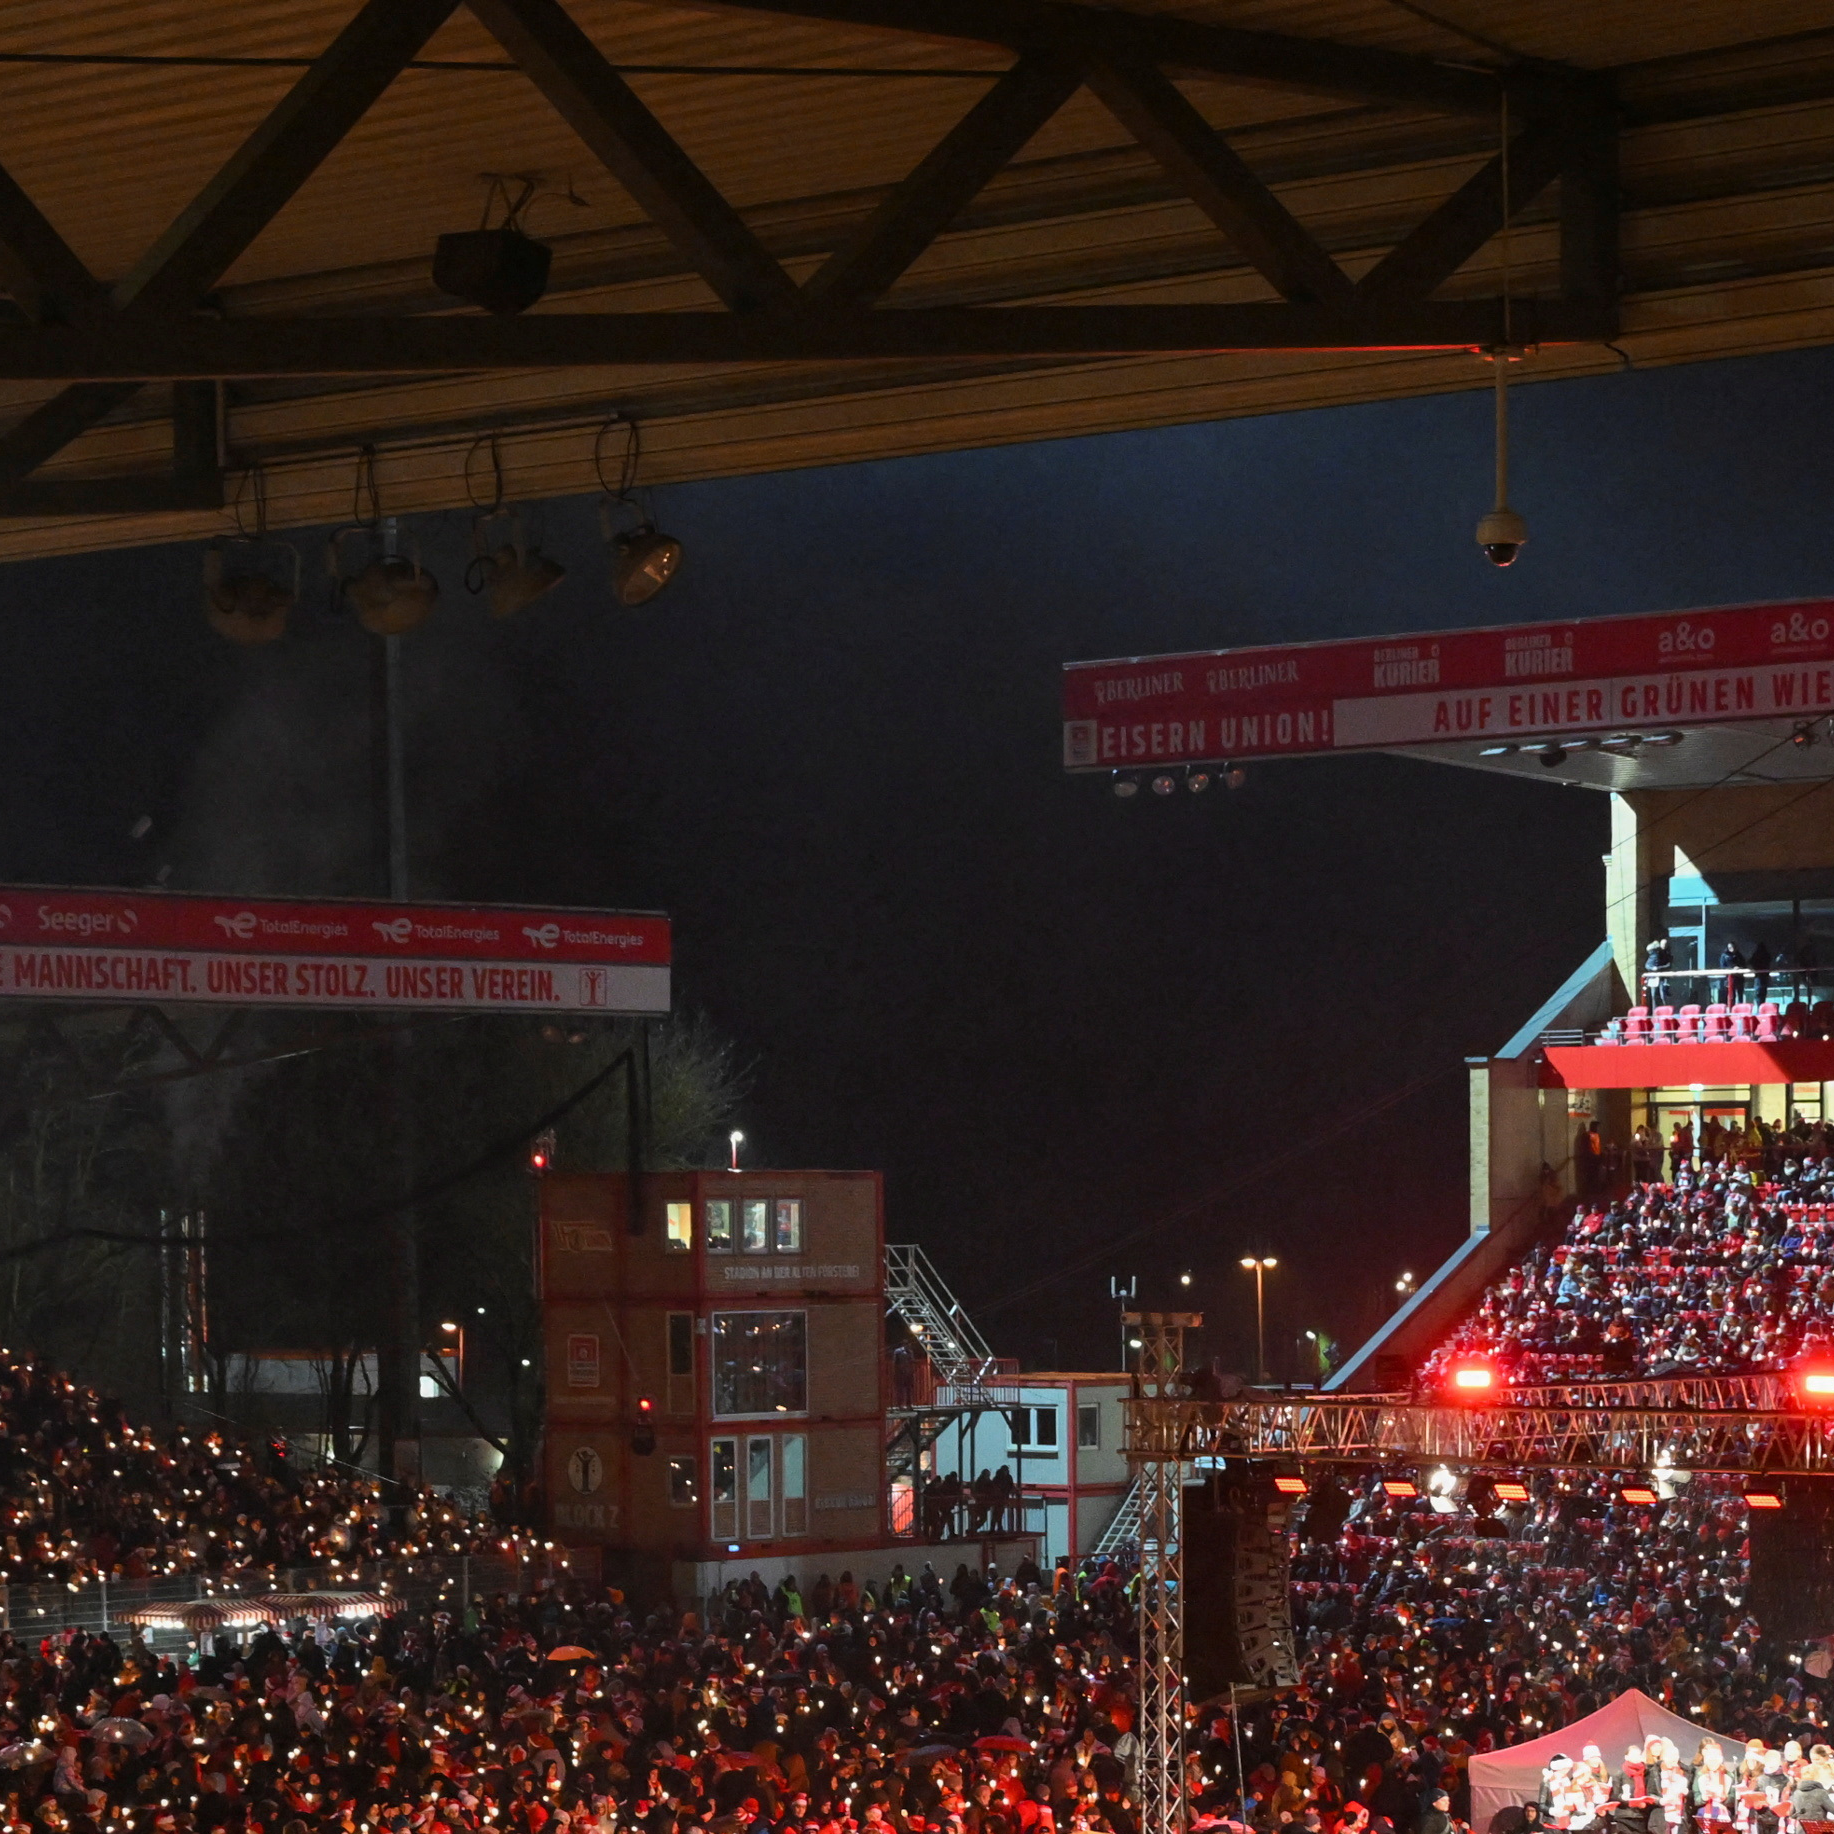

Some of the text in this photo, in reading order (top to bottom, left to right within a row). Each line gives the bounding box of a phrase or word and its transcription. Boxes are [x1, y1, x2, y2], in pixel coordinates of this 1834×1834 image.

[1657, 621, 1715, 652] a&o
[1770, 612, 1829, 643] a&o
[1218, 660, 1299, 690] BERLINER
[1374, 659, 1440, 688] KURIER
[1505, 647, 1574, 677] KURIER
[1105, 671, 1184, 701] BERLINER
[1433, 697, 1493, 732] AUF
[1508, 689, 1603, 727] EINER
[1620, 676, 1754, 719] GRÜNEN
[1101, 720, 1206, 758] EISERN
[1220, 709, 1330, 749] UNION!
[38, 905, 115, 937] Seeger
[261, 918, 349, 940] TotalEnergies
[415, 924, 500, 943] TotalEnergies
[563, 931, 644, 948] TotalEnergies
[16, 953, 197, 993] MANNSCHAFT.
[206, 960, 289, 997] UNSER
[296, 965, 377, 999] STOLZ.
[386, 966, 465, 1000] UNSER
[472, 968, 561, 1003] VEREIN.
